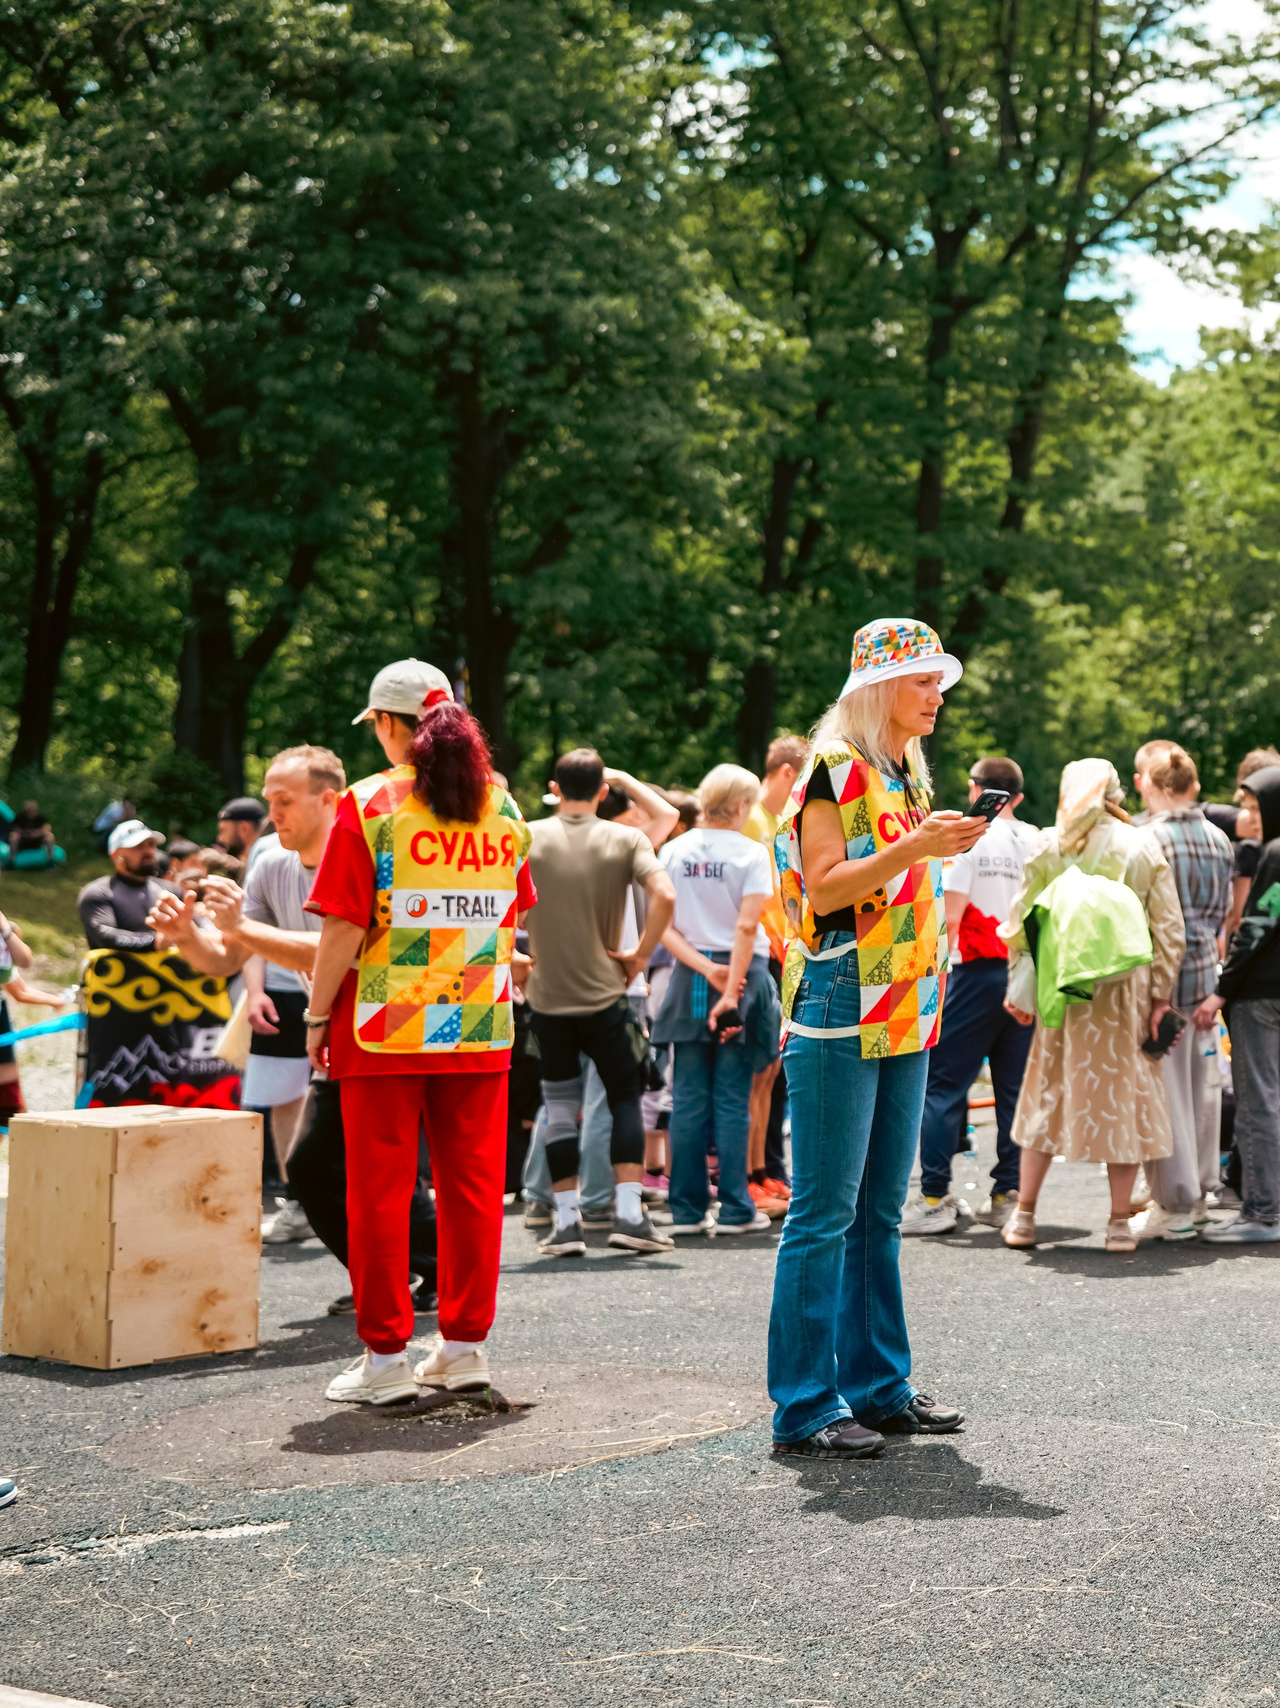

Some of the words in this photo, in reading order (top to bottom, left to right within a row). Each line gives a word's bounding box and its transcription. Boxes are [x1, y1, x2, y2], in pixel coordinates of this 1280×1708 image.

[410, 830, 516, 872] СУДЬЯ
[683, 861, 700, 877] ЗА
[705, 860, 727, 878] БЕГ
